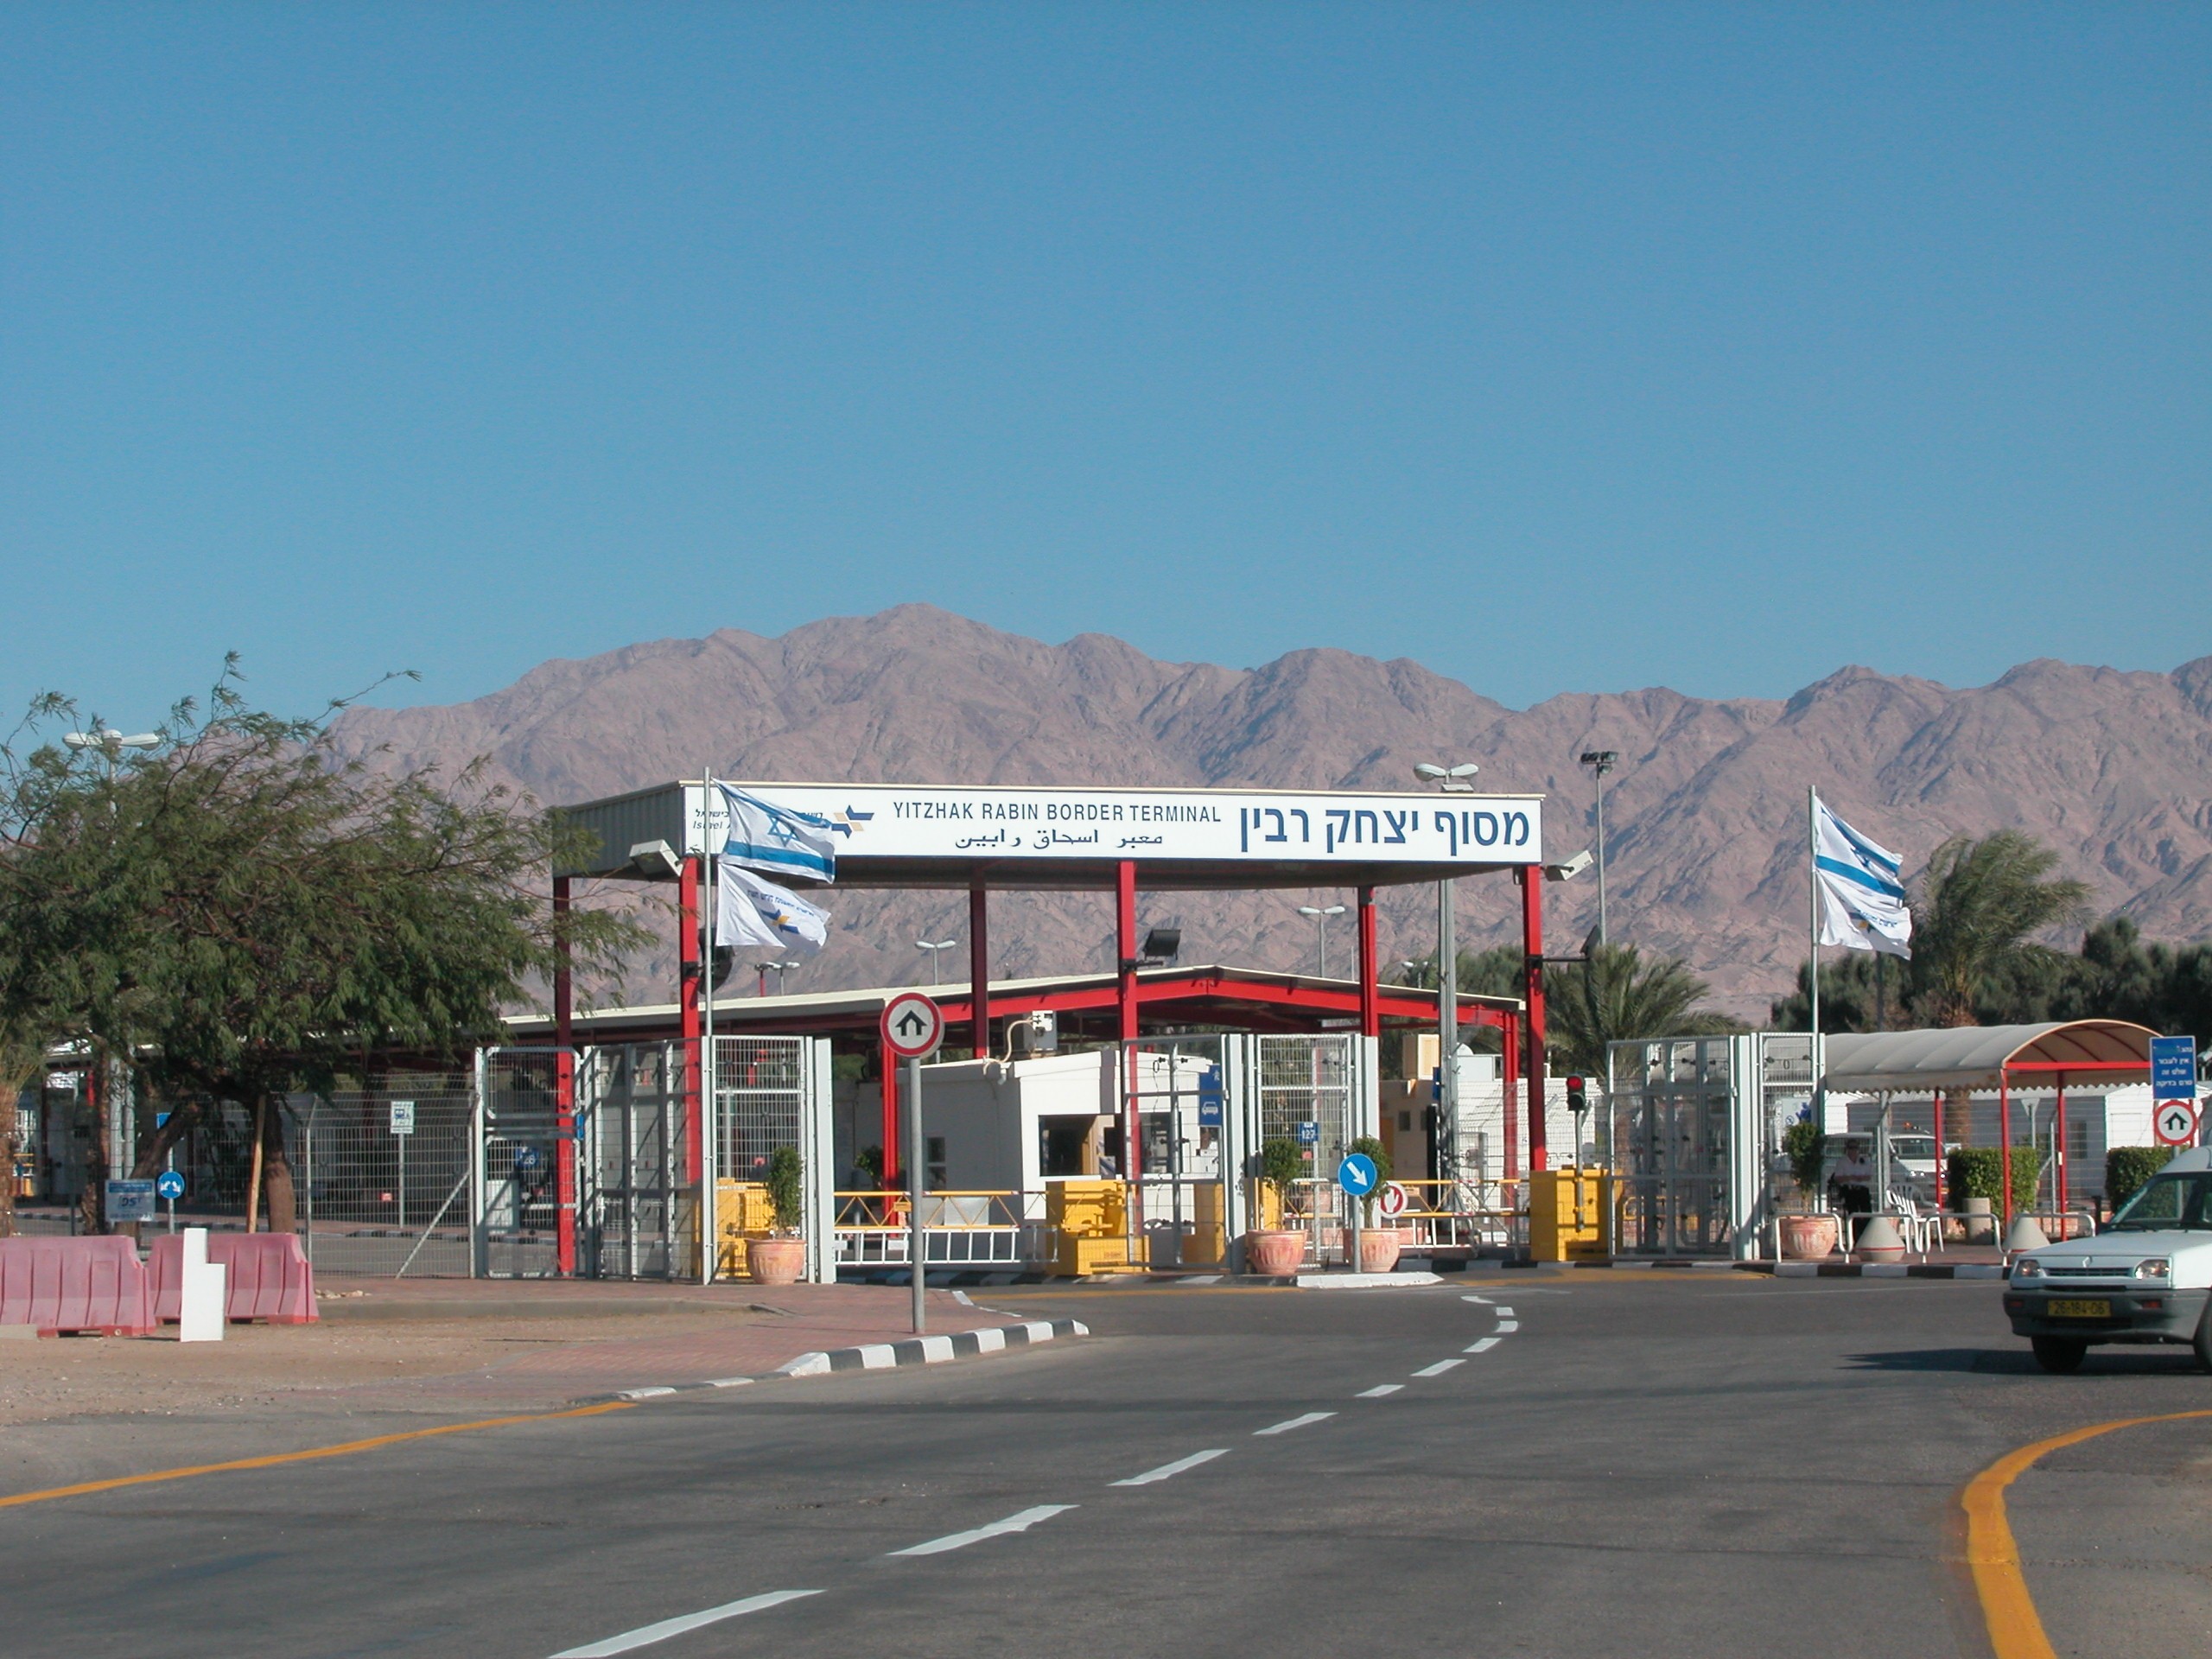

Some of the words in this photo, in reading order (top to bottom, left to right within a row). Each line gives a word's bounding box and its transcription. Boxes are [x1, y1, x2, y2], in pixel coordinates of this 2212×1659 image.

[893, 801, 974, 819] YITZHAK
[982, 803, 1039, 820] RABIN
[1046, 804, 1123, 822] BORDER
[1129, 805, 1222, 823] TERMINAL
[955, 828, 1021, 849] رابين
[1033, 829, 1099, 849] اسحاق
[1240, 808, 1310, 853] רבין
[1325, 810, 1419, 854] יצחק
[1433, 810, 1530, 856] מסוף
[1115, 835, 1163, 849] معبر
[1301, 1128, 1315, 1140] 127
